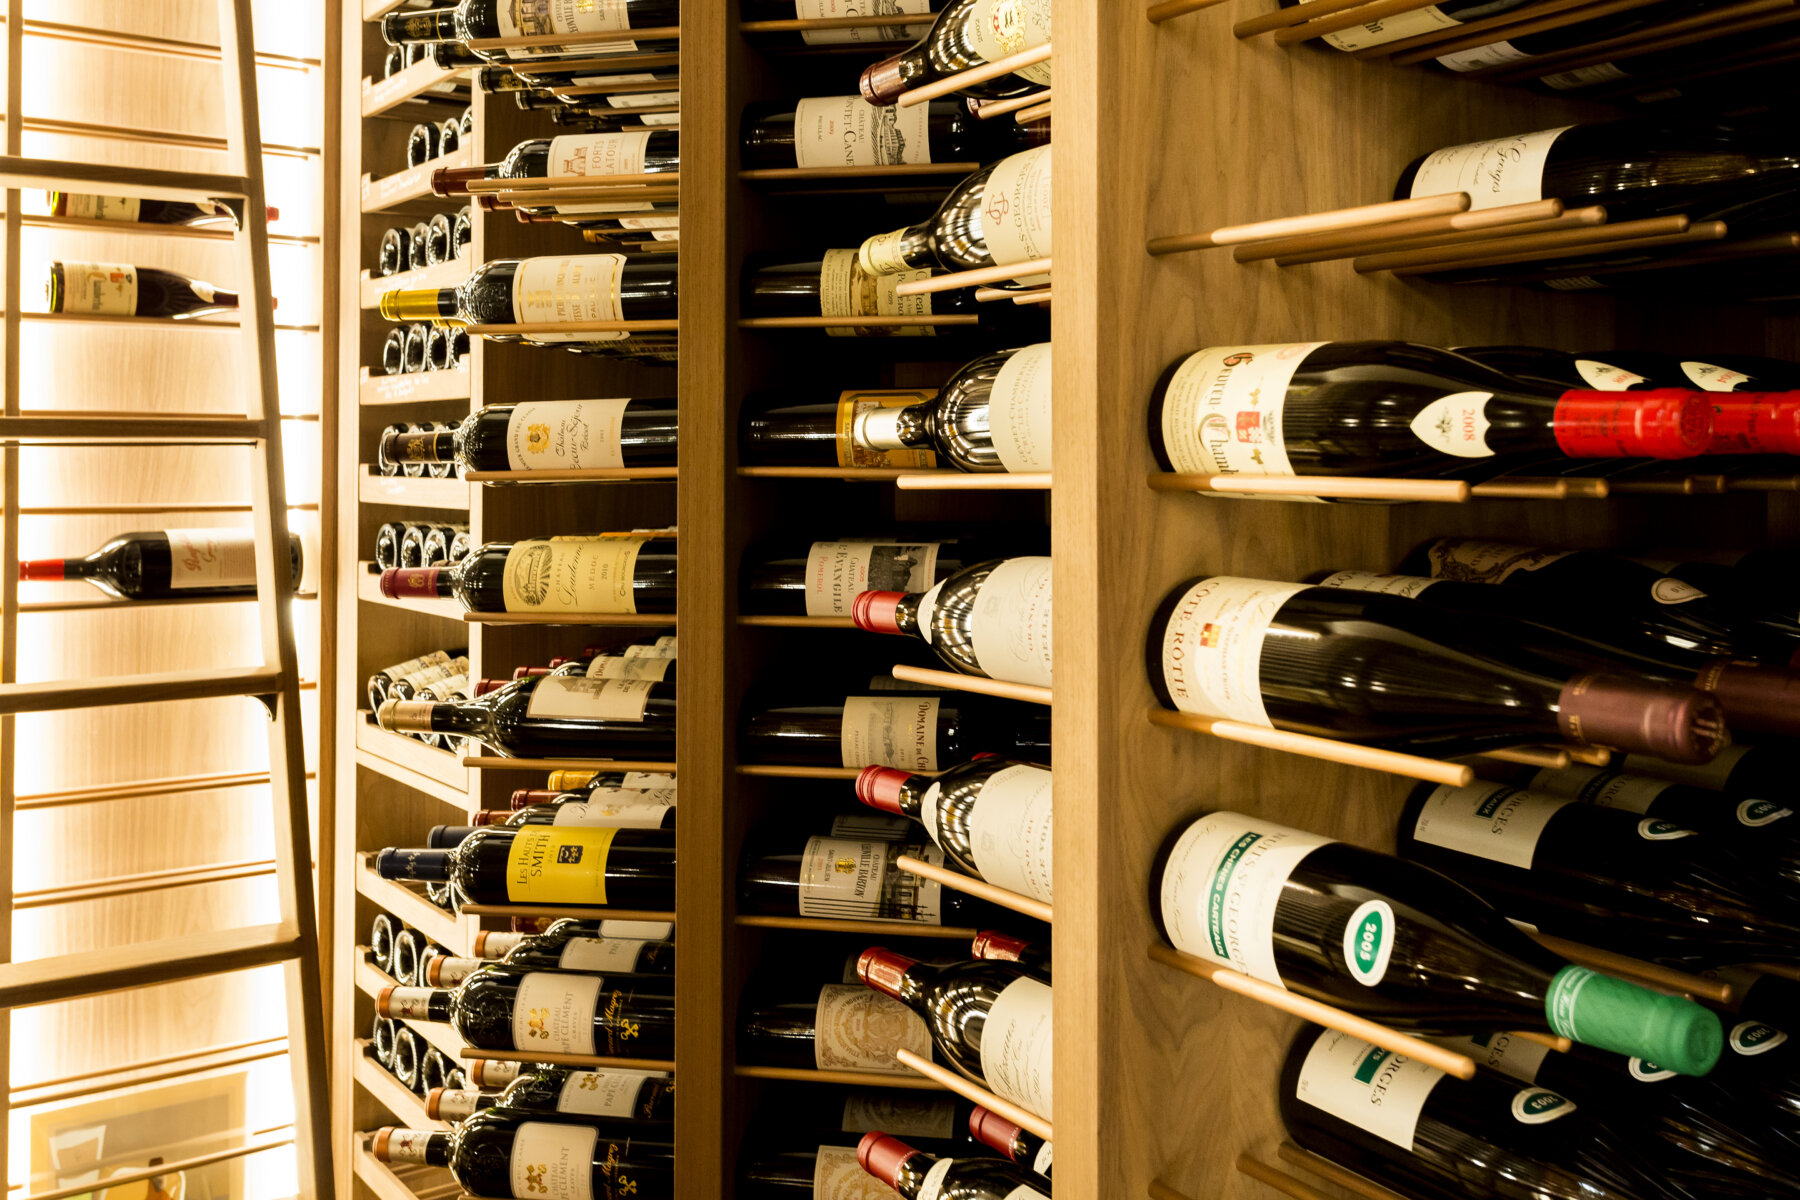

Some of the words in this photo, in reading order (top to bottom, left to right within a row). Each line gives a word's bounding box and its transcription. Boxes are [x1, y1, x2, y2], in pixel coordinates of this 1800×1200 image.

[591, 140, 605, 169] FORTS
[605, 138, 617, 176] LATOUR
[915, 270, 928, 315] Cteau
[1461, 407, 1476, 442] 2008
[816, 556, 829, 595] POMEROL
[916, 702, 931, 747] DOMAINE
[1490, 793, 1529, 836] ORGES
[530, 834, 551, 878] SMITH
[1237, 832, 1257, 848] LES
[516, 868, 529, 885] LES
[854, 869, 870, 898] BARTON
[1211, 893, 1226, 956] CARTEAUX
[1358, 922, 1378, 962] 2005
[1369, 1054, 1408, 1107] ORGES
